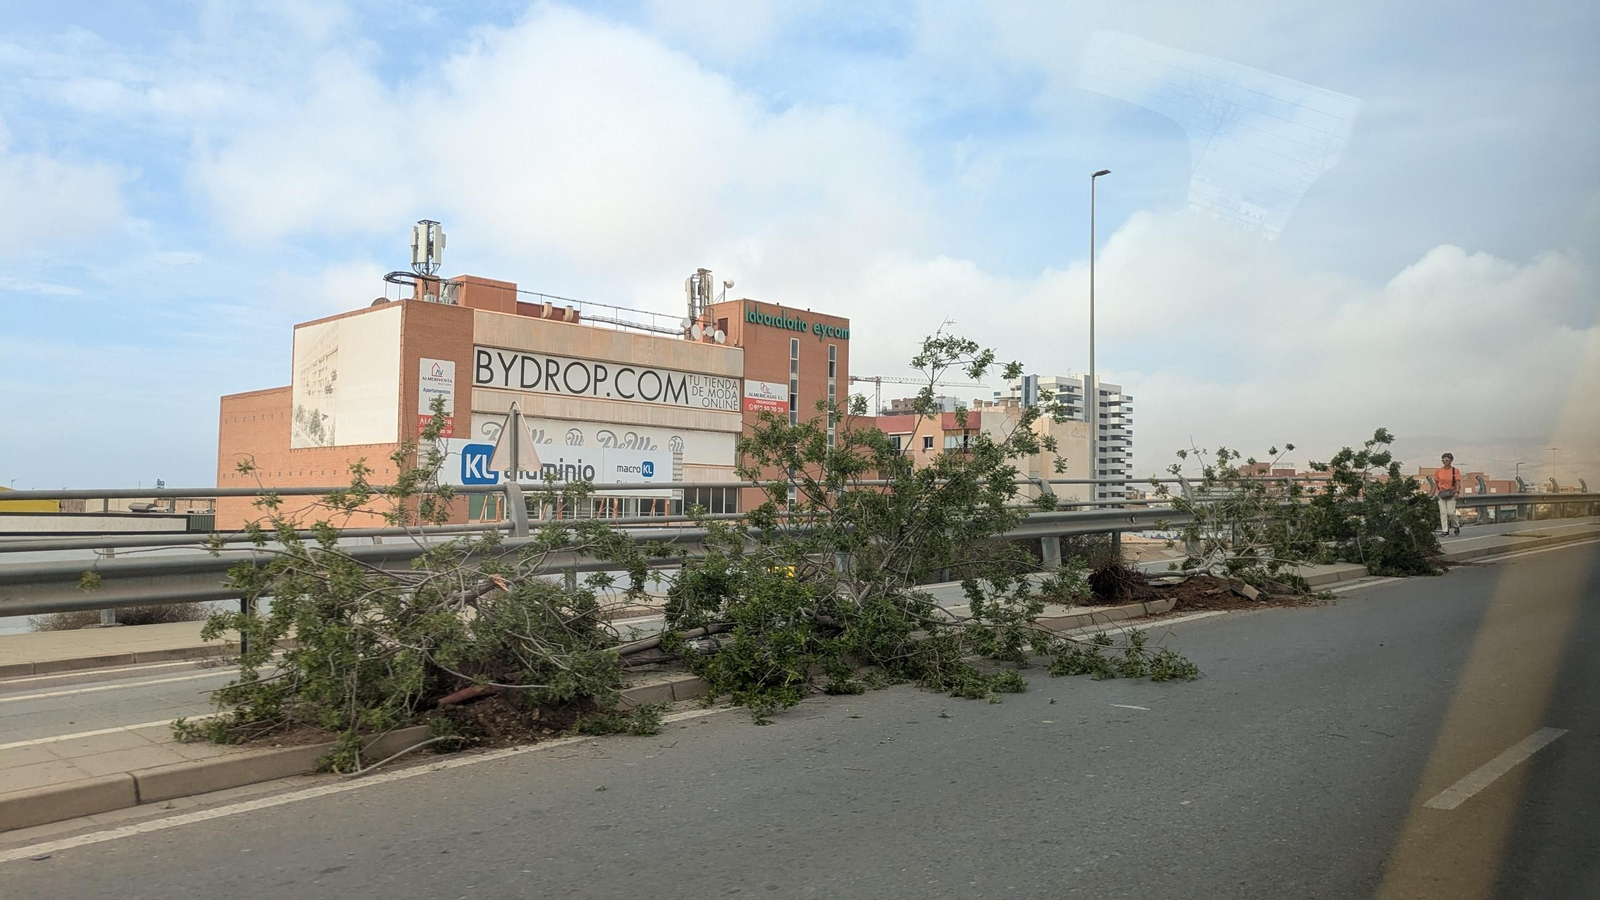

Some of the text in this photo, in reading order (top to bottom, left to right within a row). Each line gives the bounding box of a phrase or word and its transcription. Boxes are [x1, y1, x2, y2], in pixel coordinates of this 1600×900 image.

[745, 302, 850, 341] laboratorio eycom
[475, 349, 689, 405] BYDROP.COM
[688, 374, 738, 390] TU TIENDA
[691, 386, 738, 400] DE MODA
[702, 397, 738, 410] ONLINE
[466, 453, 495, 479] KL
[617, 464, 653, 475] macro KL
